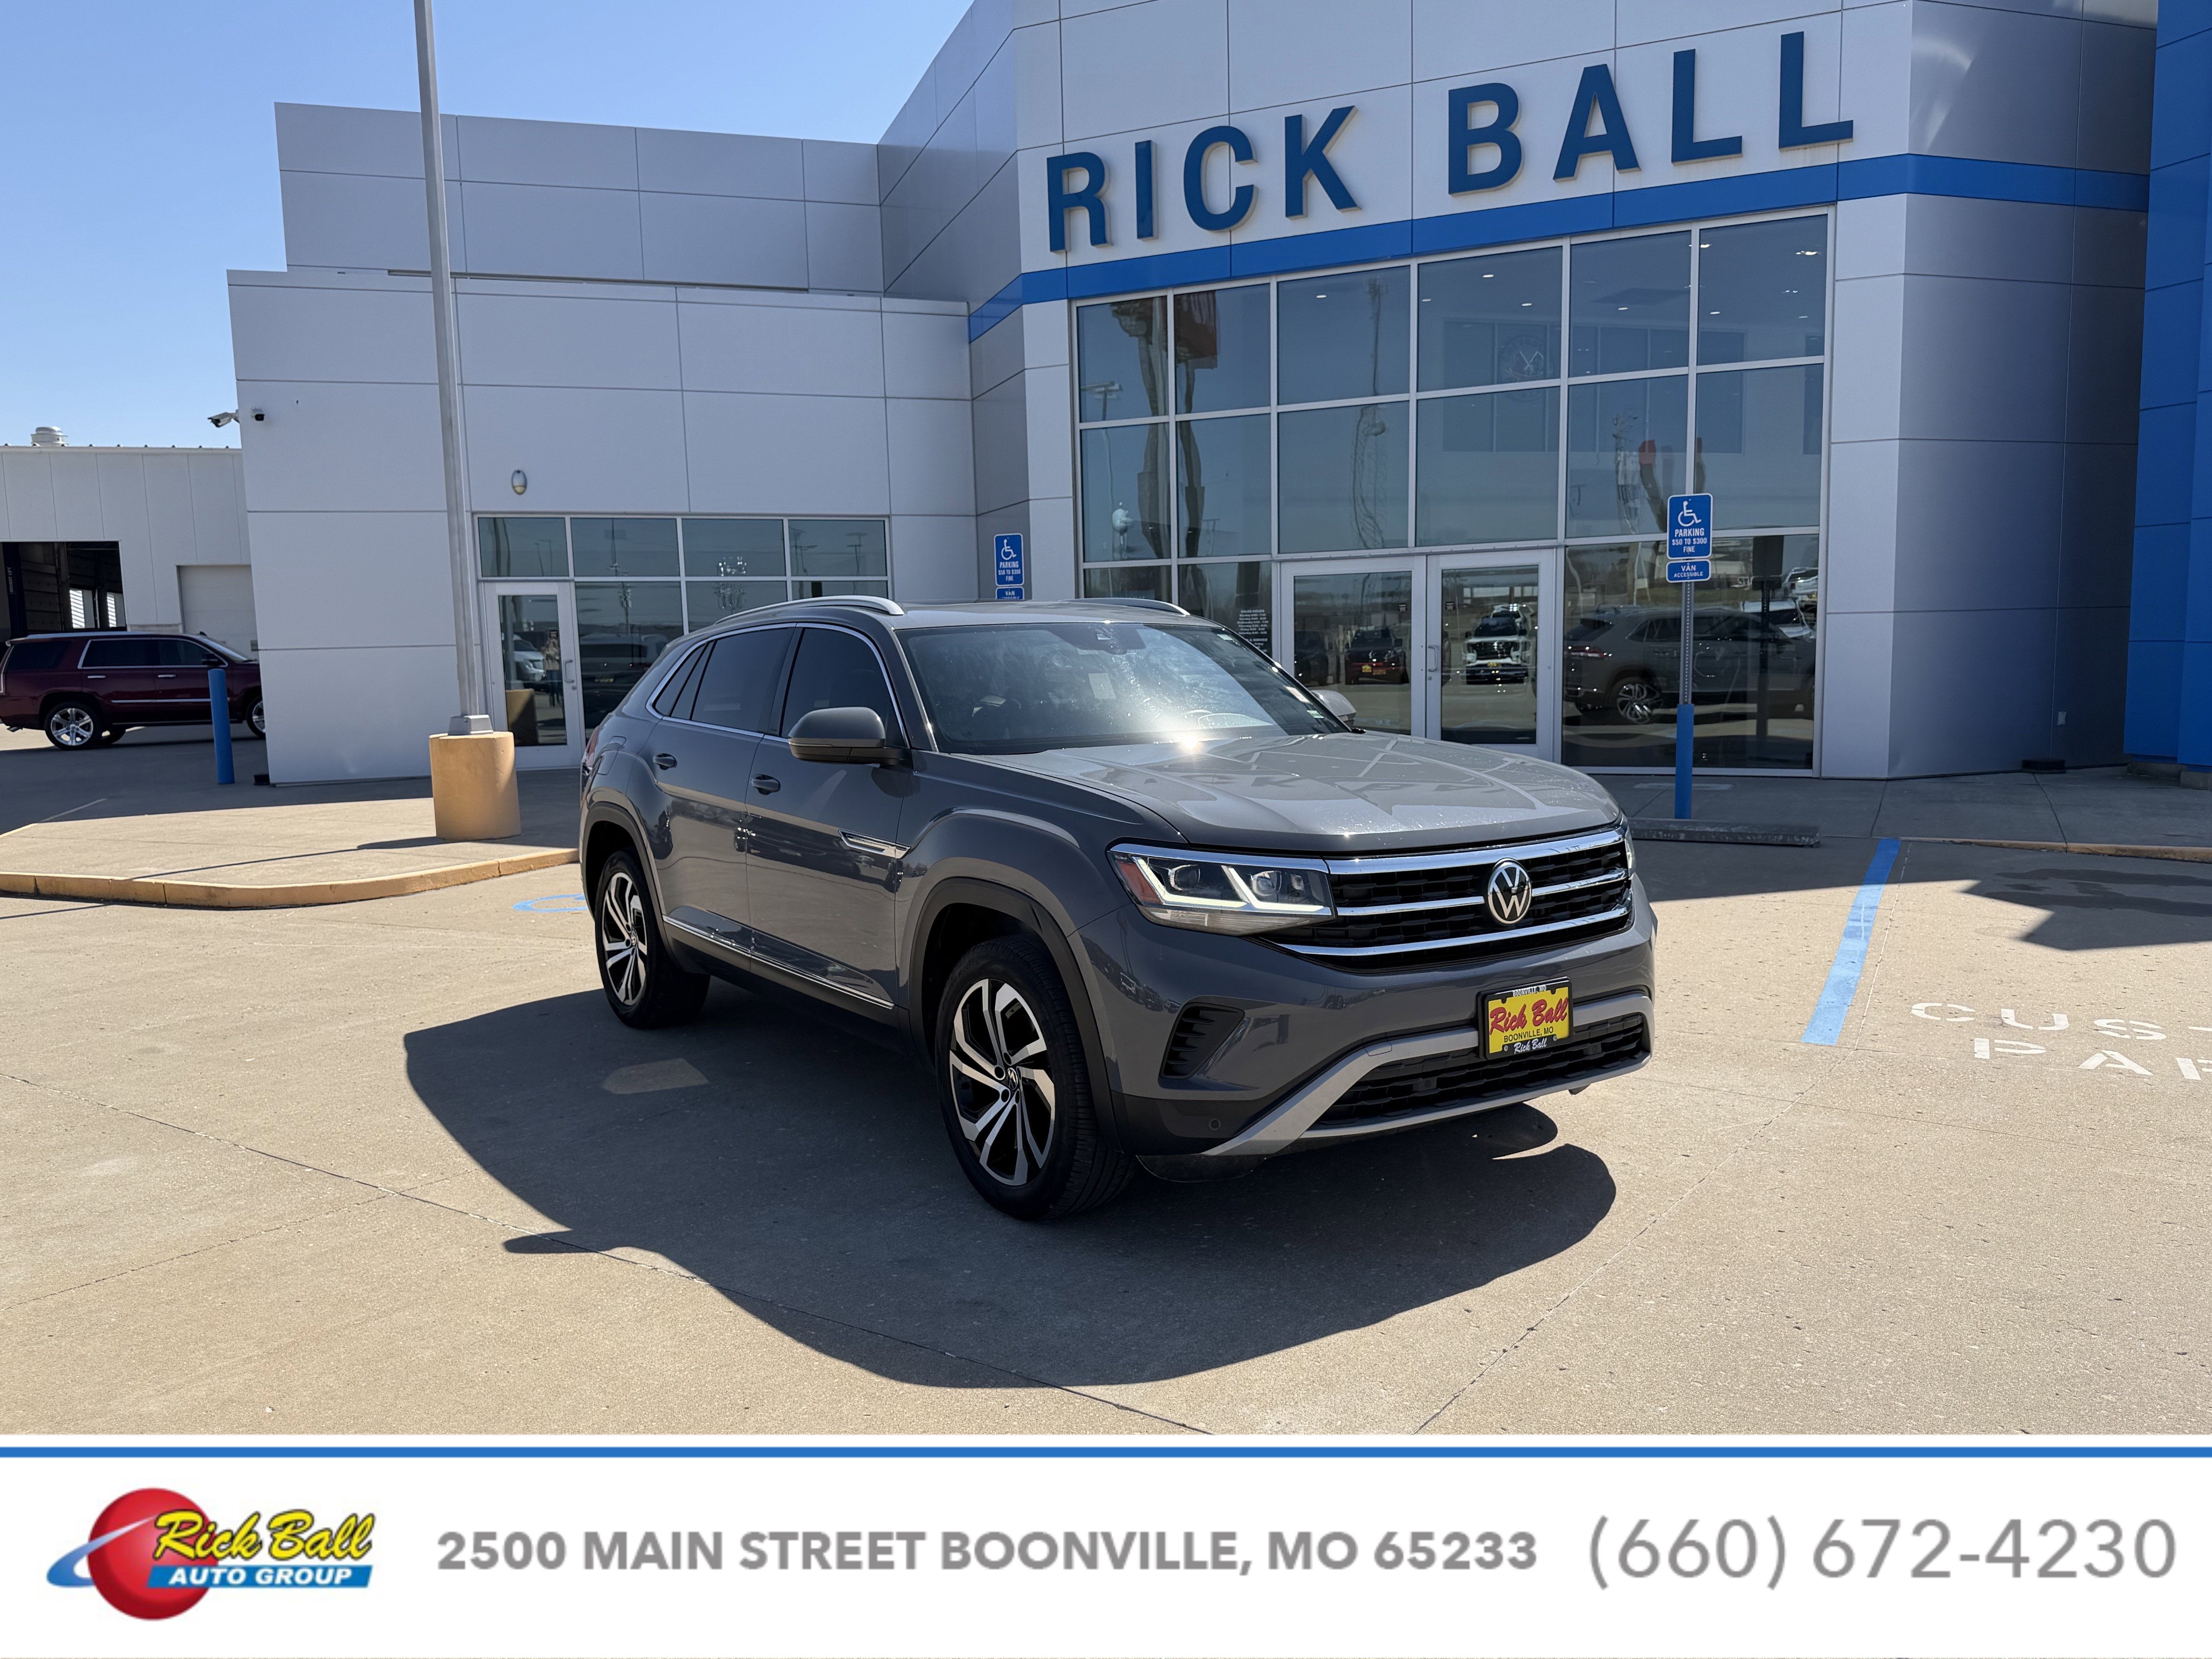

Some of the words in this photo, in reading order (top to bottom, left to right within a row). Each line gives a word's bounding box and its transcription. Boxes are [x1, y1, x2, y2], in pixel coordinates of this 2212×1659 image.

[1047, 106, 1361, 252] RICK
[1448, 31, 1853, 194] BALL
[1674, 528, 1704, 538] PARKING
[1491, 865, 1530, 920] VW
[1490, 1003, 1527, 1035] Rick
[1532, 997, 1568, 1026] Ball
[1504, 1029, 1542, 1042] BOONVILLE,
[1544, 1026, 1554, 1034] MO
[1911, 1002, 2212, 1040] CUS
[1513, 1041, 1530, 1054] Rick
[1532, 1037, 1547, 1050] Ball
